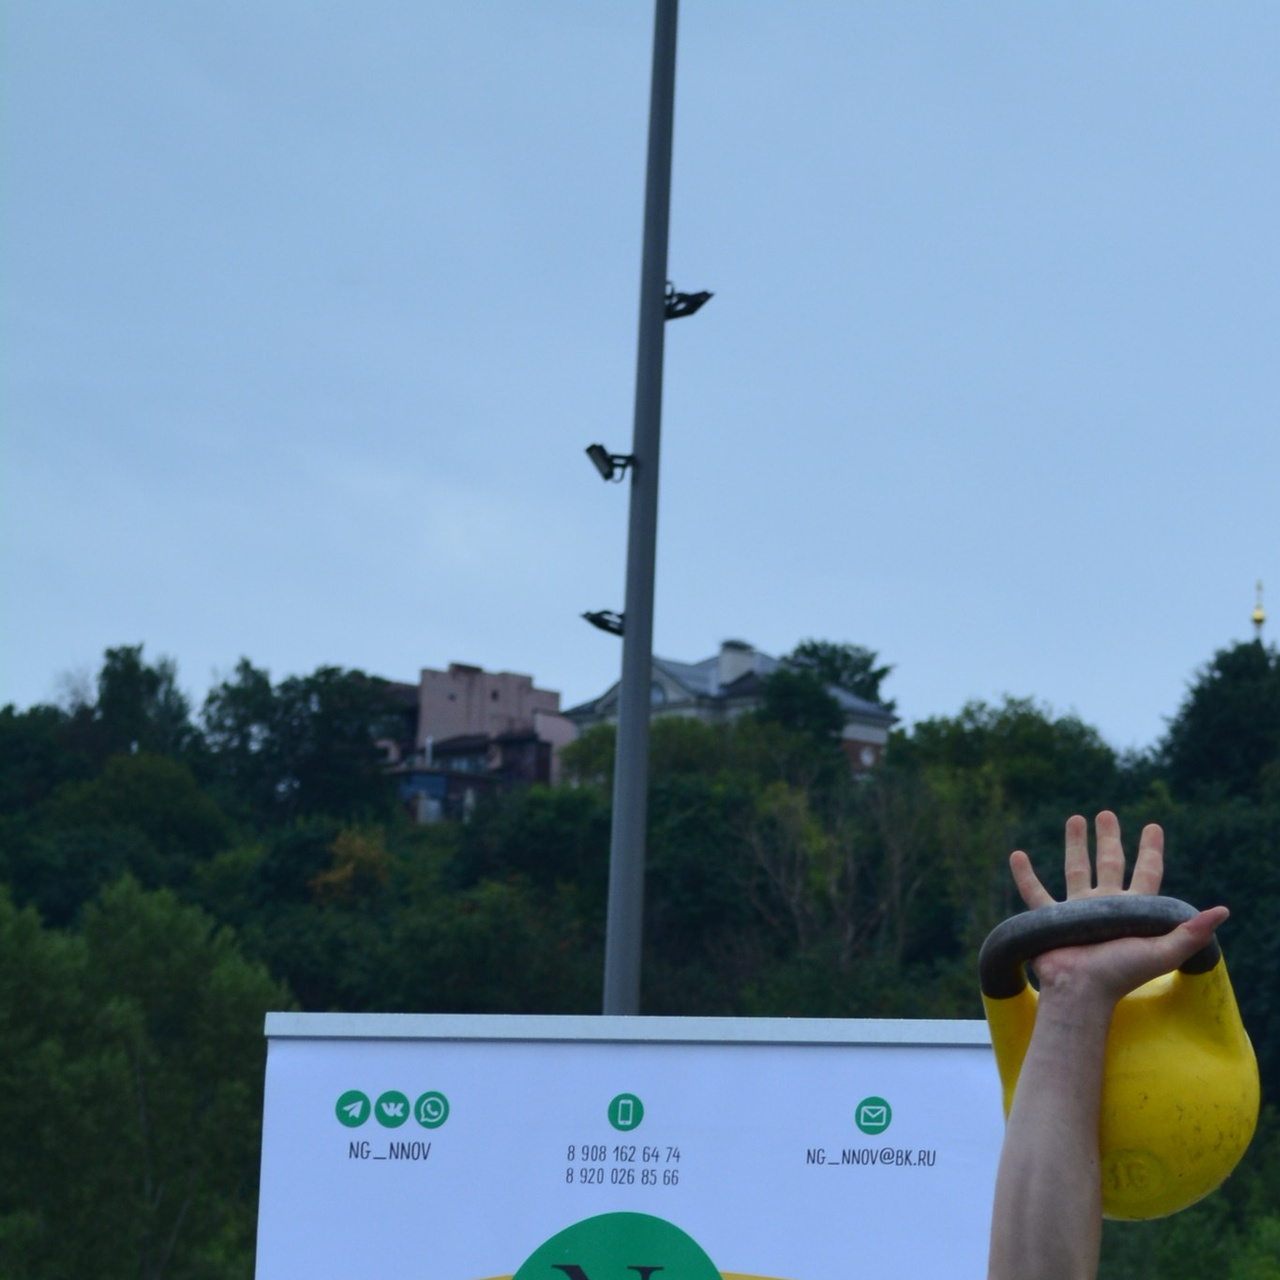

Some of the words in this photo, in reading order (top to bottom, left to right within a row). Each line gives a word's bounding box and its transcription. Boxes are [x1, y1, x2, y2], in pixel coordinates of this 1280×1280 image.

[348, 1140, 432, 1161] NG_NNOV
[567, 1144, 576, 1162] 8
[581, 1144, 607, 1162] 908
[612, 1145, 637, 1163] 162
[642, 1146, 660, 1163] 64
[665, 1146, 681, 1163] 74
[806, 1147, 937, 1167] NG_NNOV@BK.RU
[565, 1167, 574, 1184] 8
[579, 1167, 605, 1185] 920
[610, 1167, 635, 1185] 026
[640, 1168, 658, 1186] 85
[662, 1169, 679, 1186] 66
